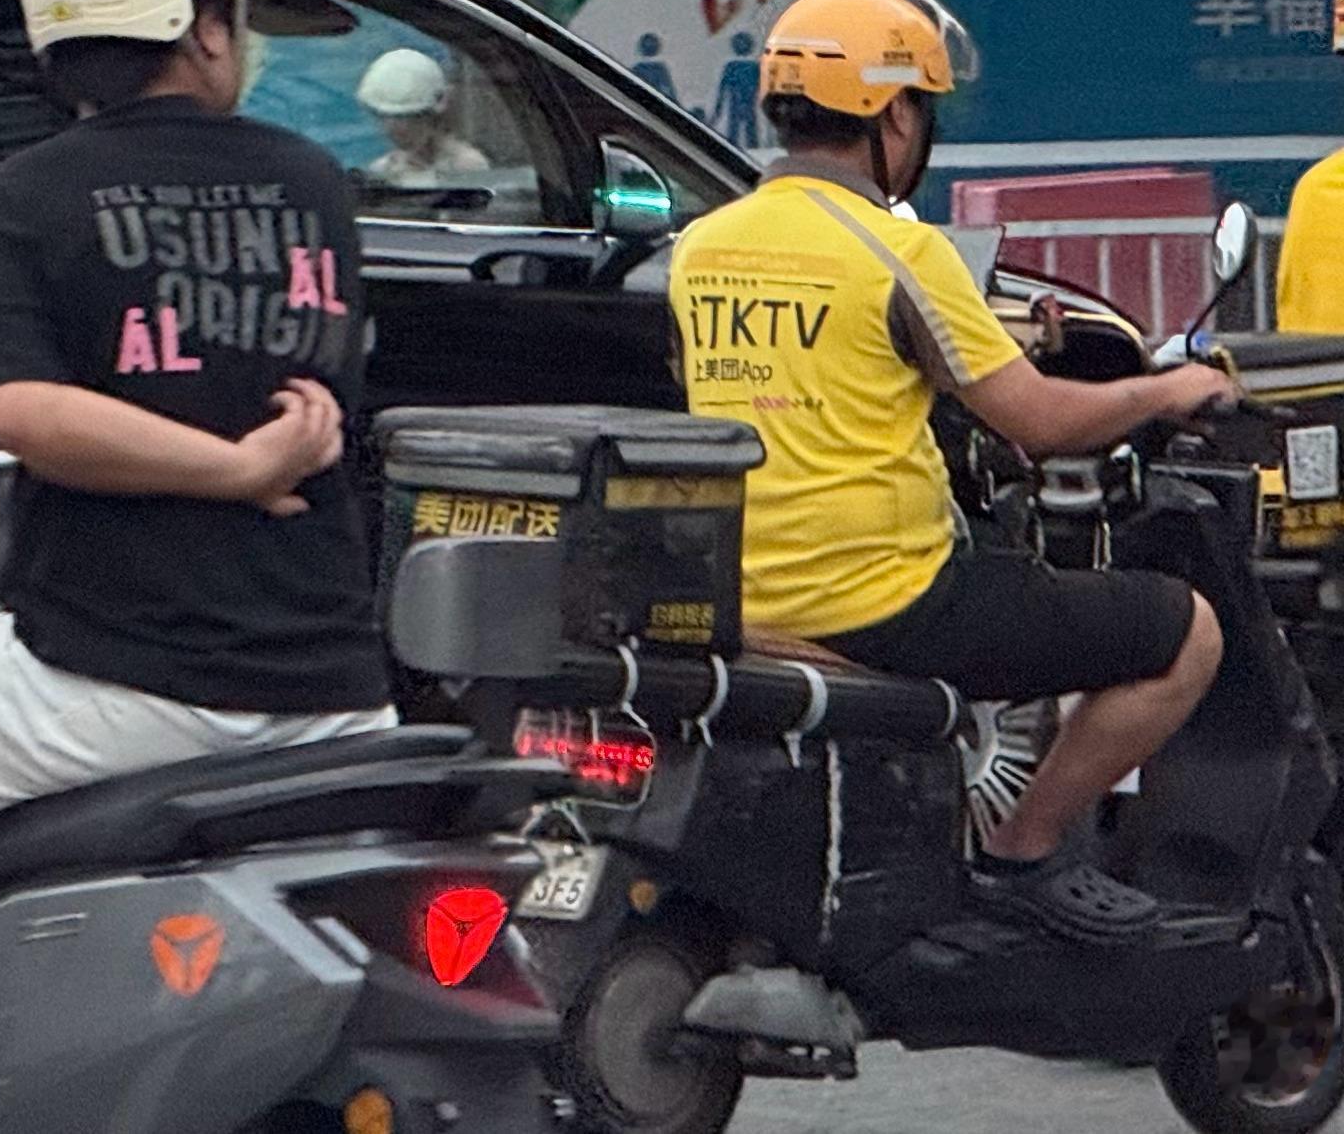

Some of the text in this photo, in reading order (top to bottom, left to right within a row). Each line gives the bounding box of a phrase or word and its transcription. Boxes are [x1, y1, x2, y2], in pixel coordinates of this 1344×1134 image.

[116, 306, 203, 374] AL
[413, 492, 561, 539] 美团配送
